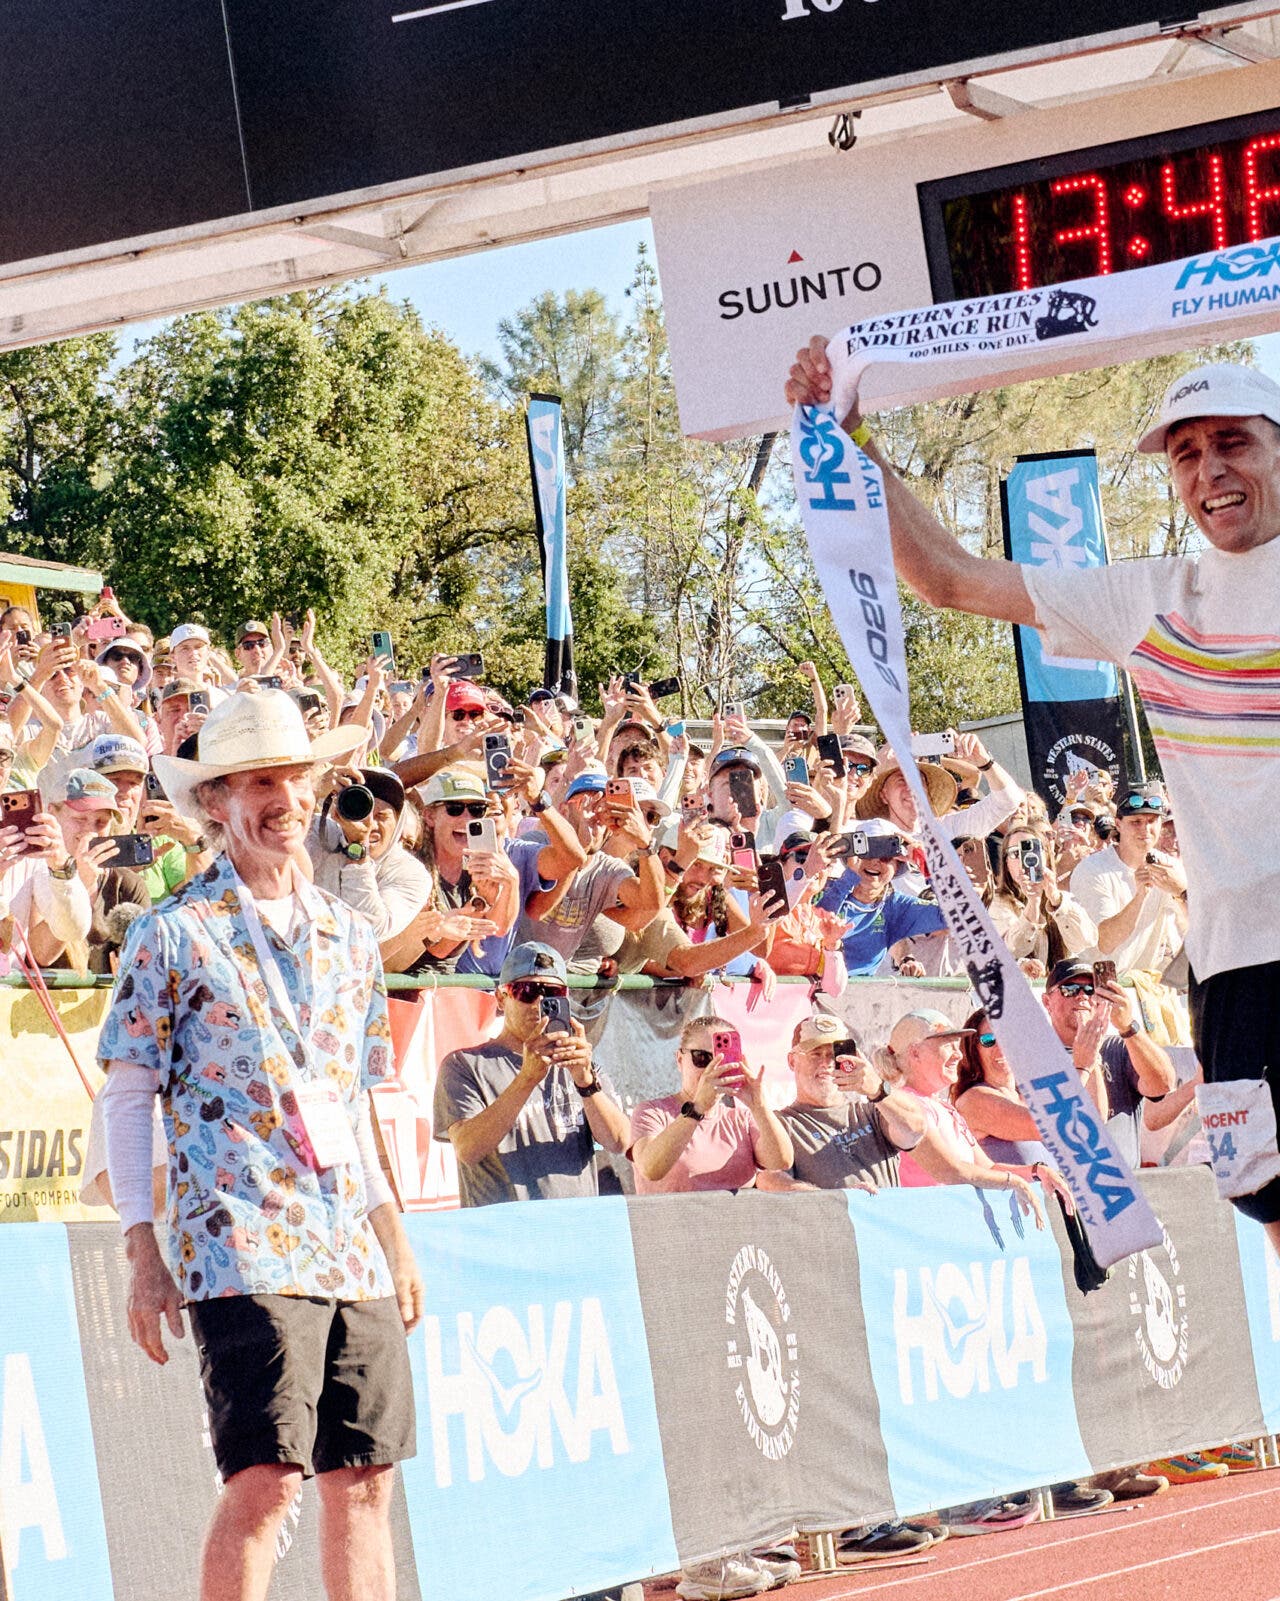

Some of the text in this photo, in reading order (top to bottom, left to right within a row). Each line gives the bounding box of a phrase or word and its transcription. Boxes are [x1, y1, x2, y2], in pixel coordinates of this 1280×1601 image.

[718, 262, 883, 320] SUUNTO
[850, 291, 1043, 336] WESTERN STATES
[1171, 291, 1204, 317] FLY
[846, 309, 1033, 358] ENDURANCE RUN
[909, 334, 1030, 359] 100 MILES ONE DAY
[1169, 380, 1211, 407] HOKA
[800, 404, 857, 511] HOK
[864, 474, 883, 510] FLY
[849, 568, 902, 693] 2026
[1047, 734, 1116, 764] WESTERN STATES
[945, 874, 994, 955] STATES
[949, 908, 975, 955] RUN
[1030, 1071, 1136, 1222] HOKA
[33, 1189, 80, 1206] COMPAN
[726, 1244, 791, 1325] WESTERN STATES
[893, 1256, 1049, 1405] HOKA
[423, 1297, 631, 1489] HOKA
[735, 1381, 794, 1460] ENDURANCE
